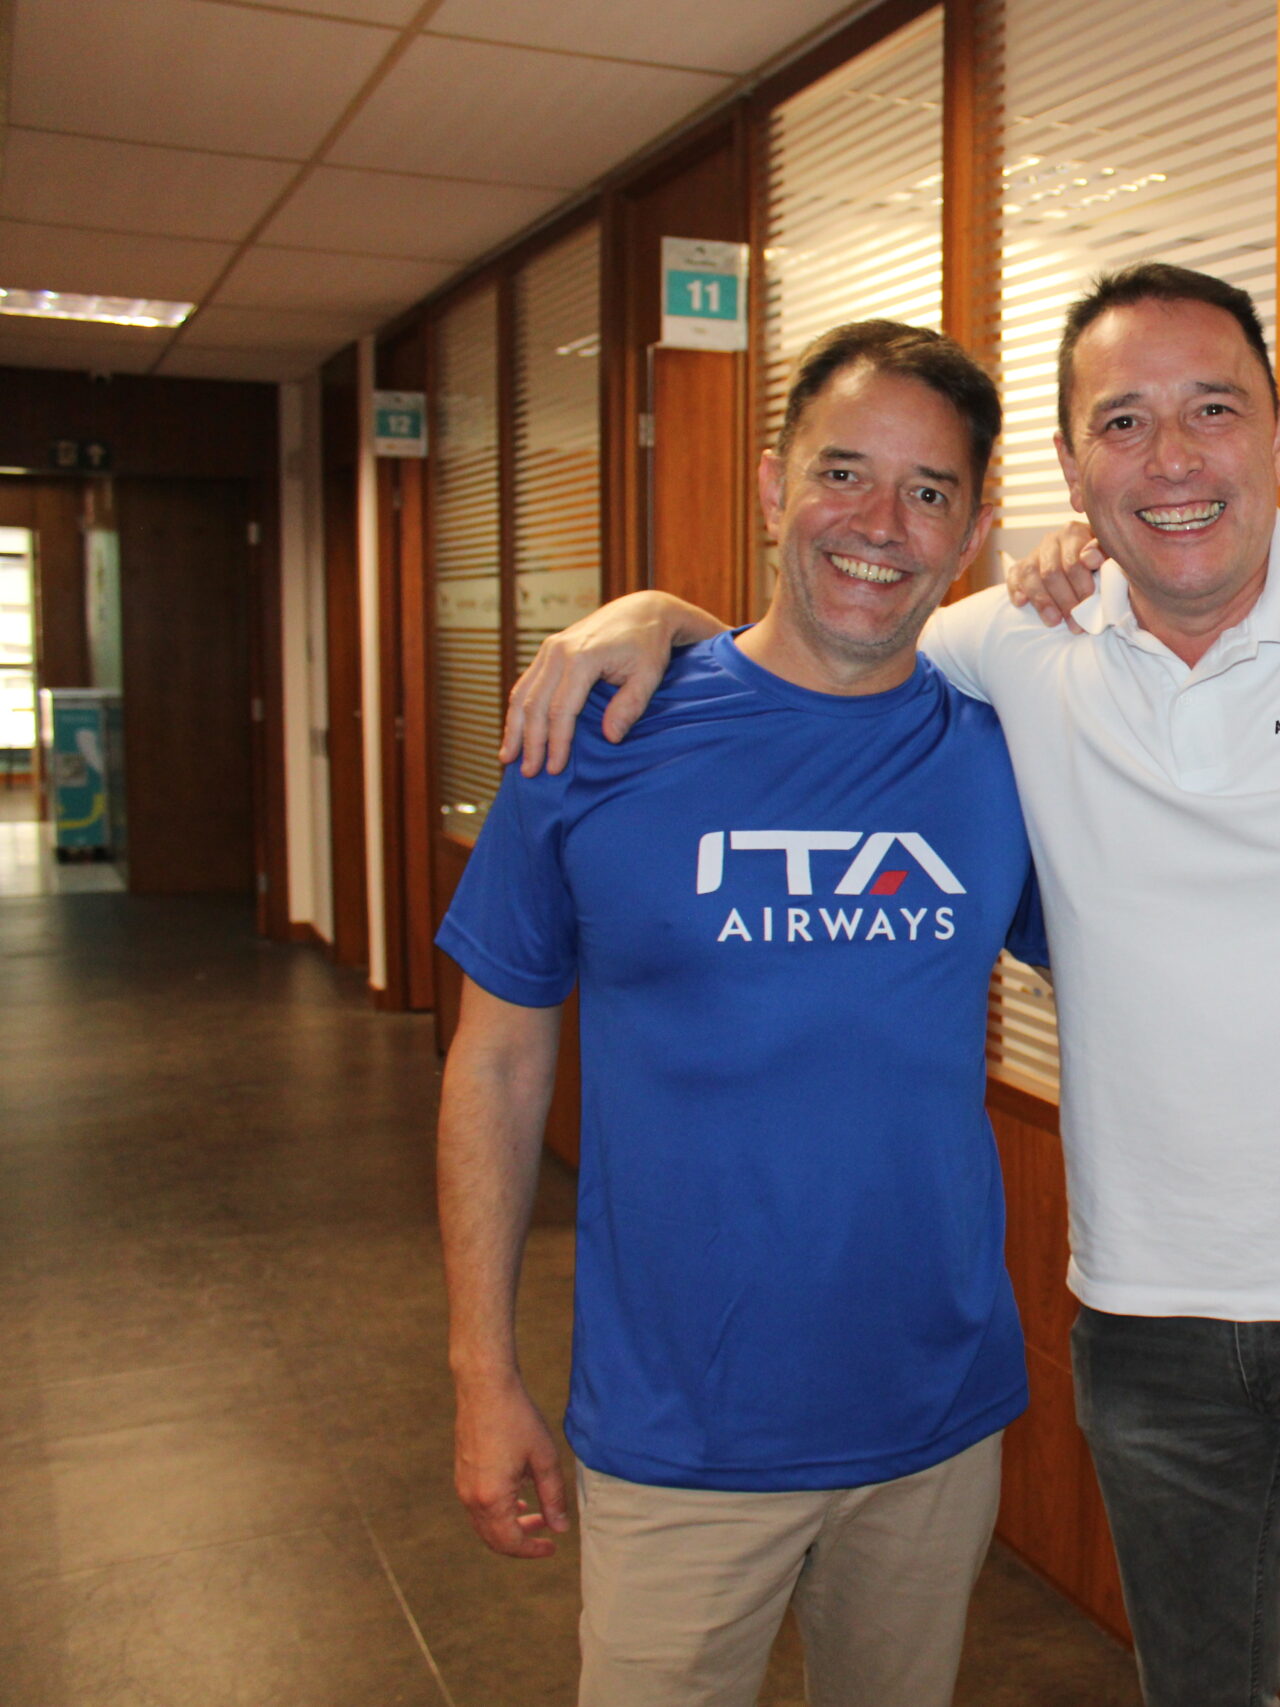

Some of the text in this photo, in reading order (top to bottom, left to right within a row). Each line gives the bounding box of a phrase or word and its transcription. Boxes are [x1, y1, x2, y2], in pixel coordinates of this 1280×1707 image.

[686, 279, 721, 313] 11
[697, 830, 967, 896] ITA
[717, 906, 956, 943] AIRWAYS
